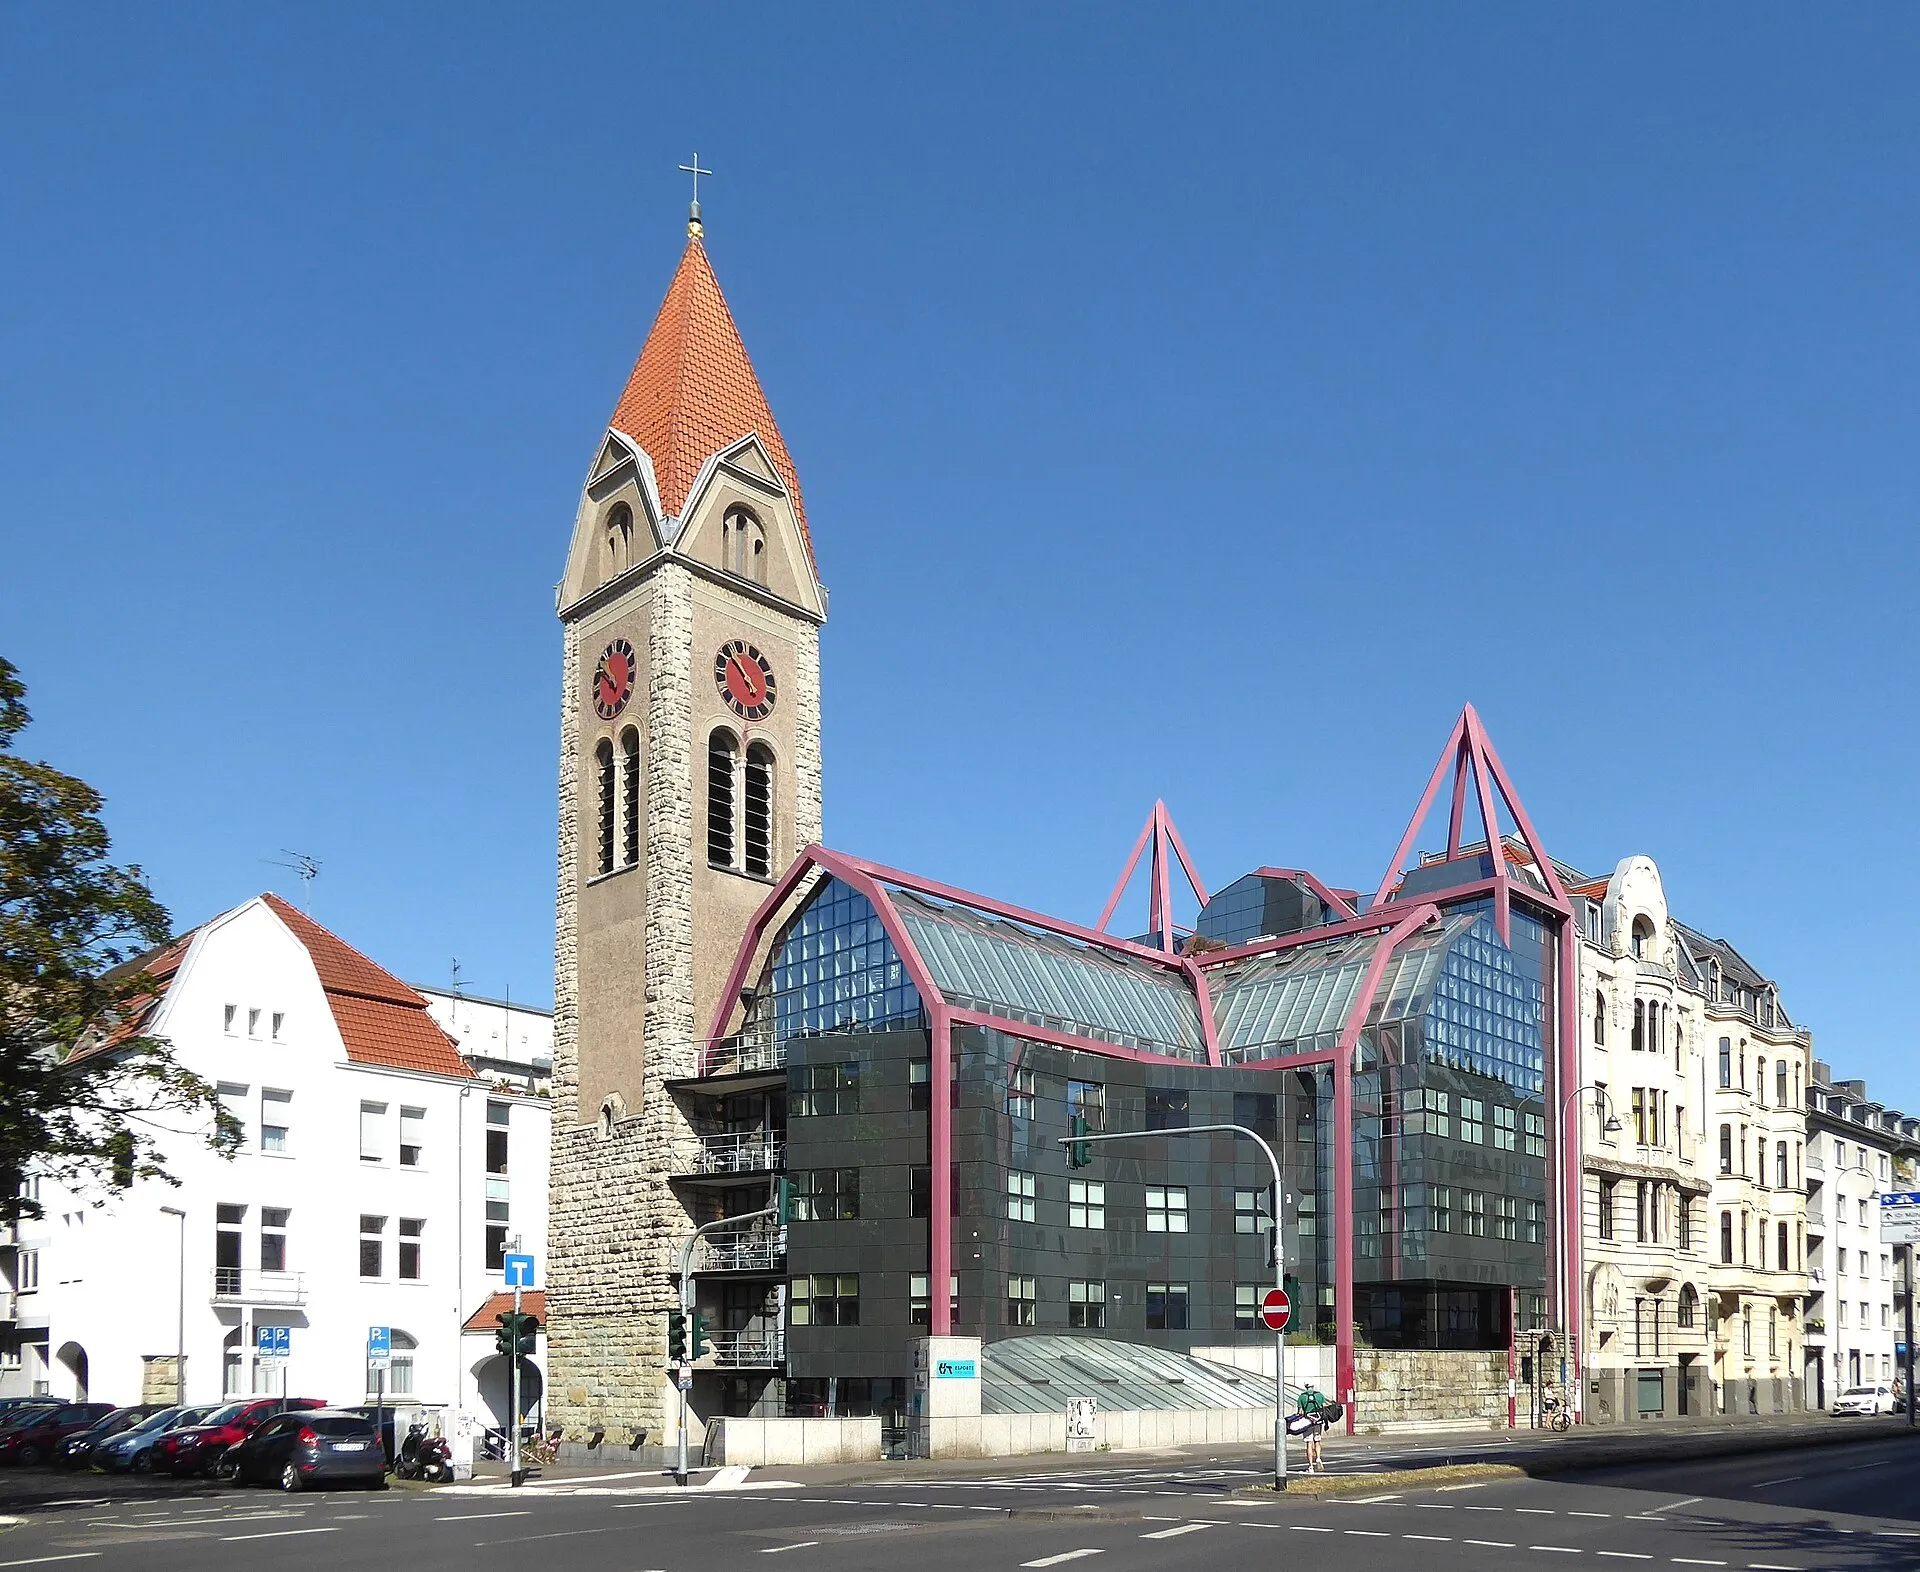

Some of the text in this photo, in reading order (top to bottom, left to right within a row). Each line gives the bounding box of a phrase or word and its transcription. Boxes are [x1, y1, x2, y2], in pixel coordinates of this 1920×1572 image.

[260, 1329, 269, 1341] P
[276, 1329, 285, 1341] P
[371, 1328, 382, 1341] P
